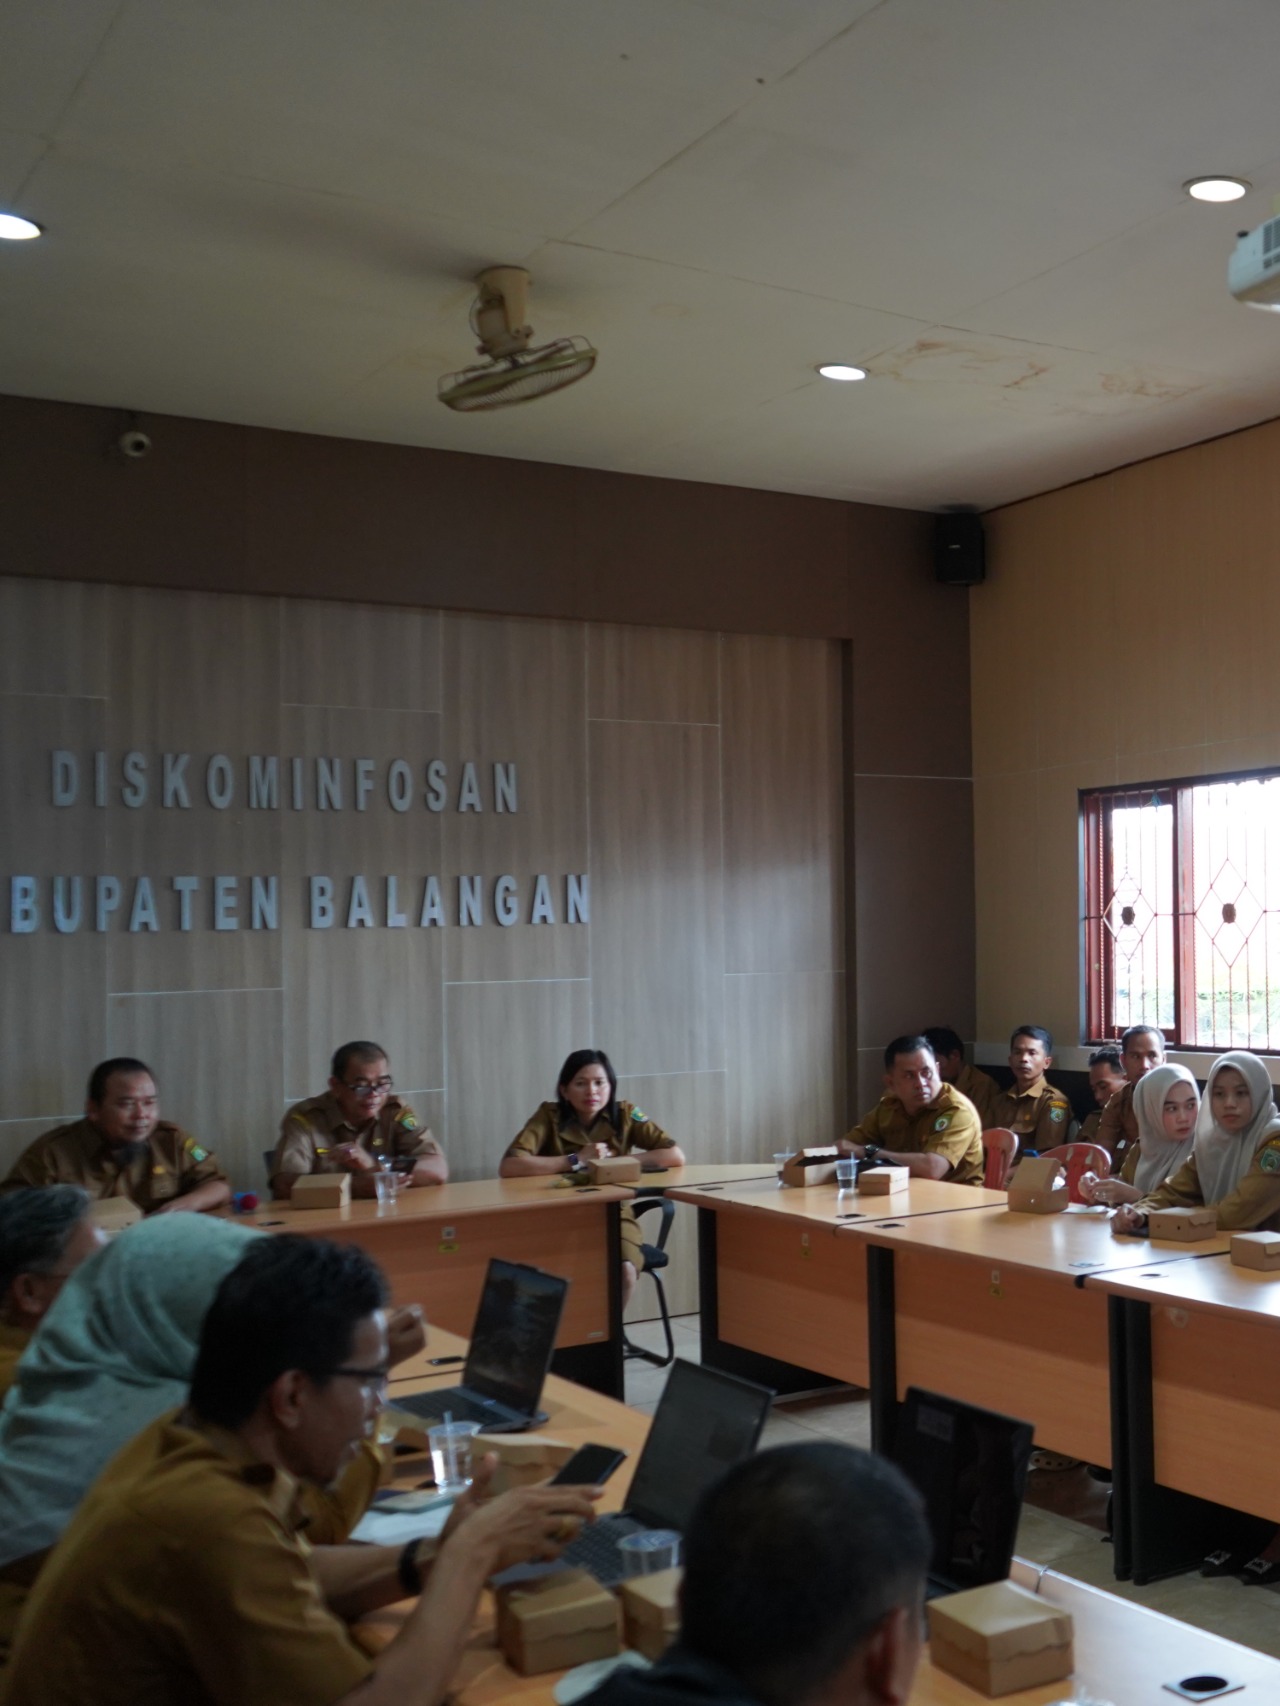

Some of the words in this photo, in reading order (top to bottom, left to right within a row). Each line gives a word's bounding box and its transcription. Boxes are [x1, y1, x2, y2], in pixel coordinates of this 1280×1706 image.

[51, 750, 518, 812] DISKOMINFOSAN
[10, 875, 279, 933] BUPATEN
[309, 874, 588, 929] BALANGAN
